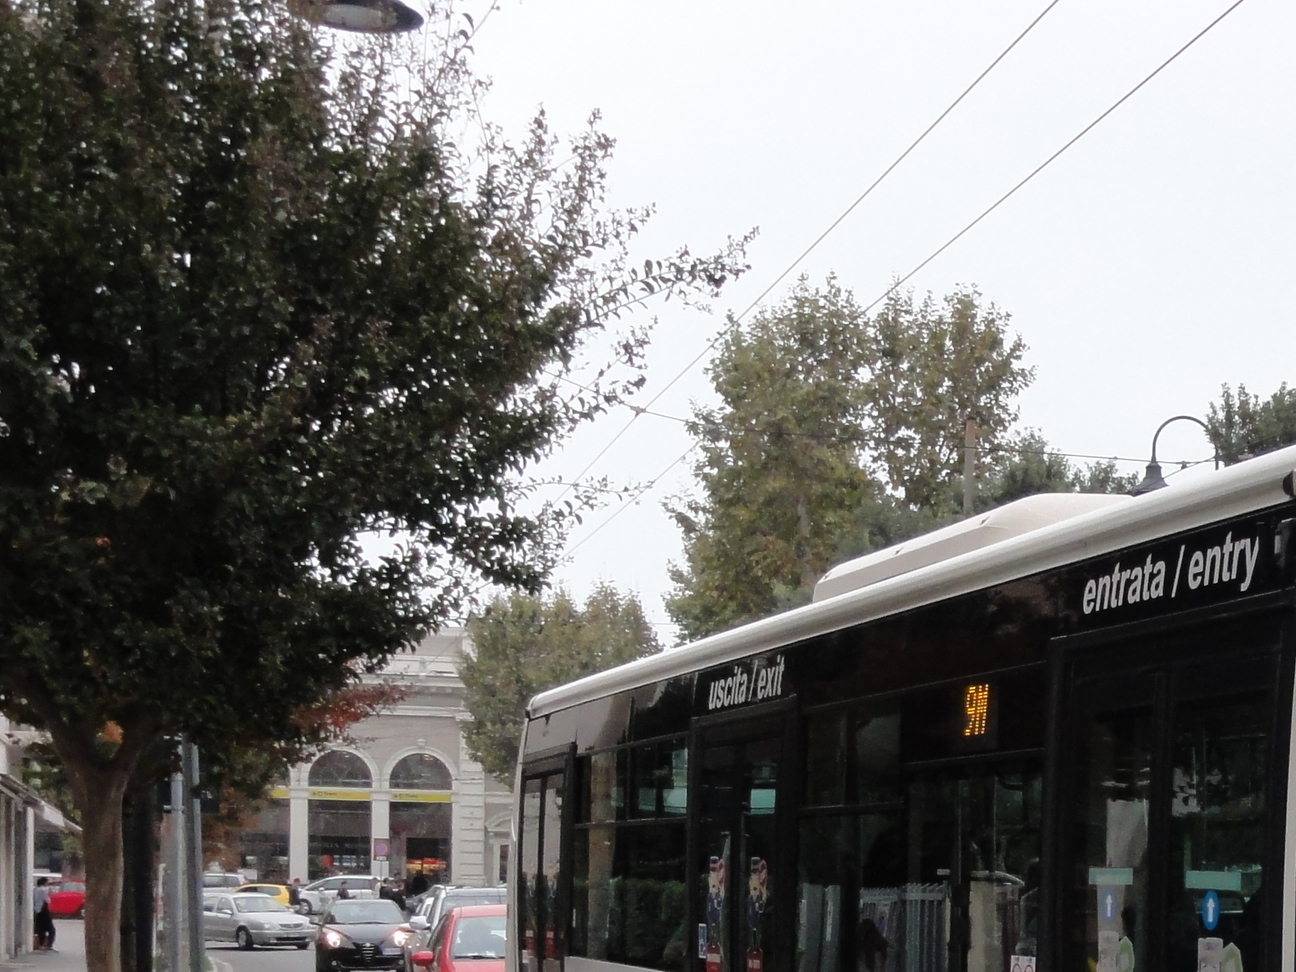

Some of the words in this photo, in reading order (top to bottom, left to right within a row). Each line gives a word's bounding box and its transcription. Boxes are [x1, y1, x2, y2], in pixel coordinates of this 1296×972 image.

[1082, 553, 1166, 615] entrata
[1188, 531, 1260, 592] entry
[708, 665, 748, 710] uscita
[758, 654, 785, 700] exit
[965, 684, 989, 736] 9M
